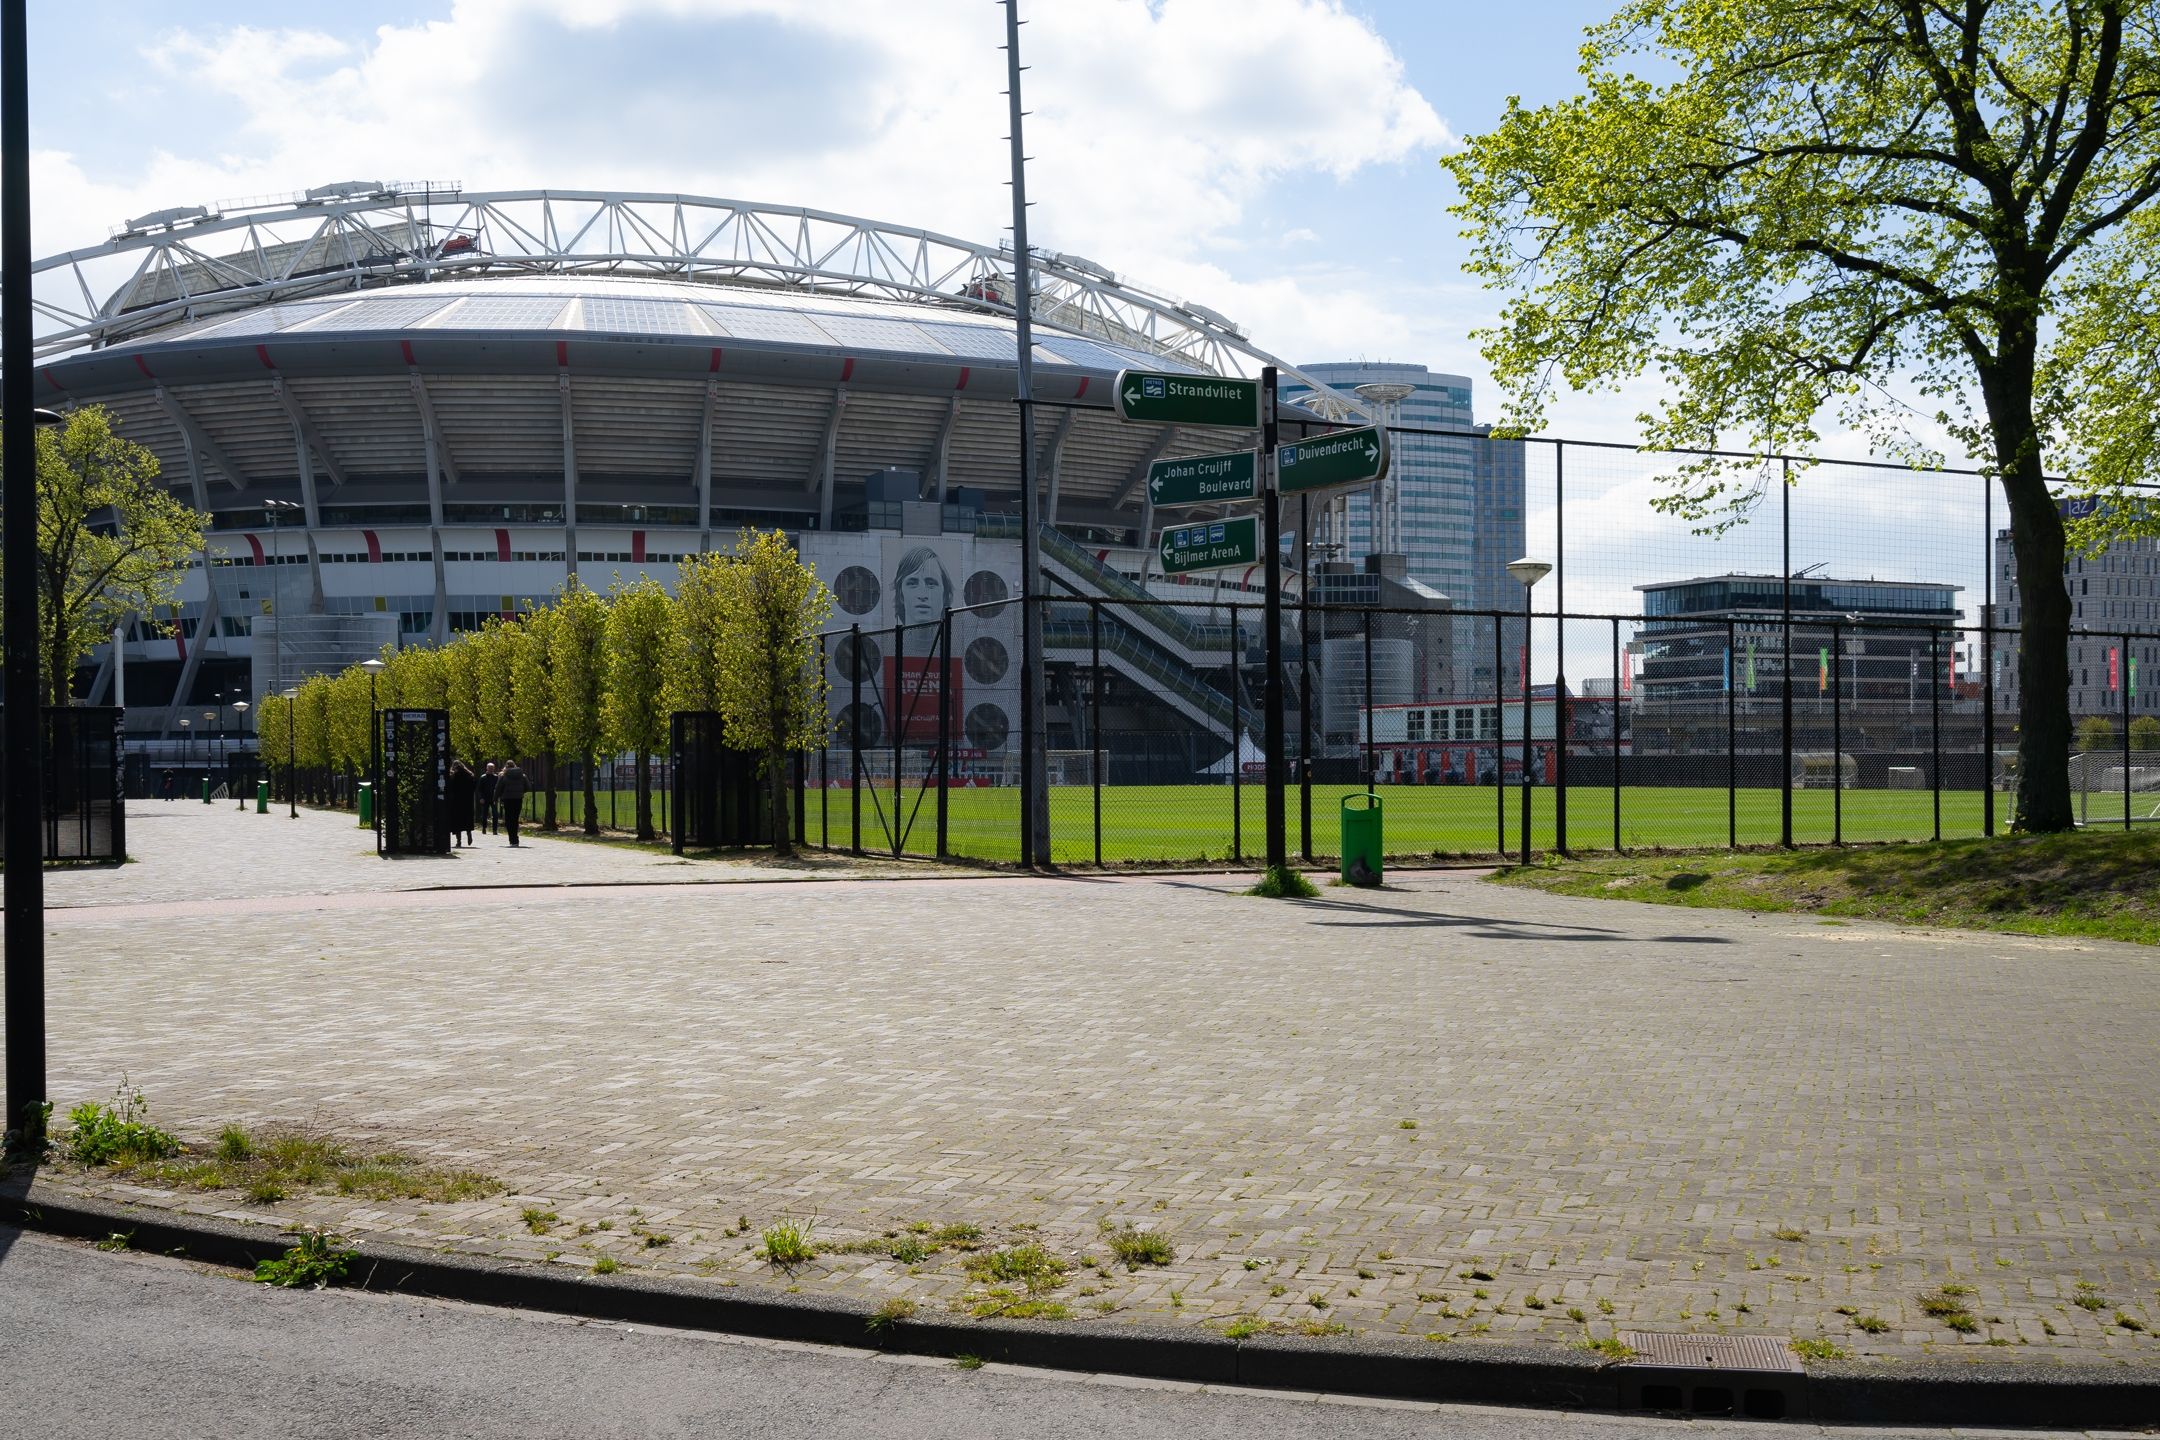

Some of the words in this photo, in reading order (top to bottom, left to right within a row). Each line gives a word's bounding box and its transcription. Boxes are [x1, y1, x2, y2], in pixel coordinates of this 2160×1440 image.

[1169, 382, 1242, 400] Strandvliet
[1298, 437, 1364, 460] Duivendrecht
[1164, 465, 1195, 478] Johan
[1197, 460, 1232, 476] Cruijff
[1199, 477, 1251, 494] Boulevard
[1174, 550, 1209, 567] Bijlmer
[1211, 544, 1241, 560] ArenA
